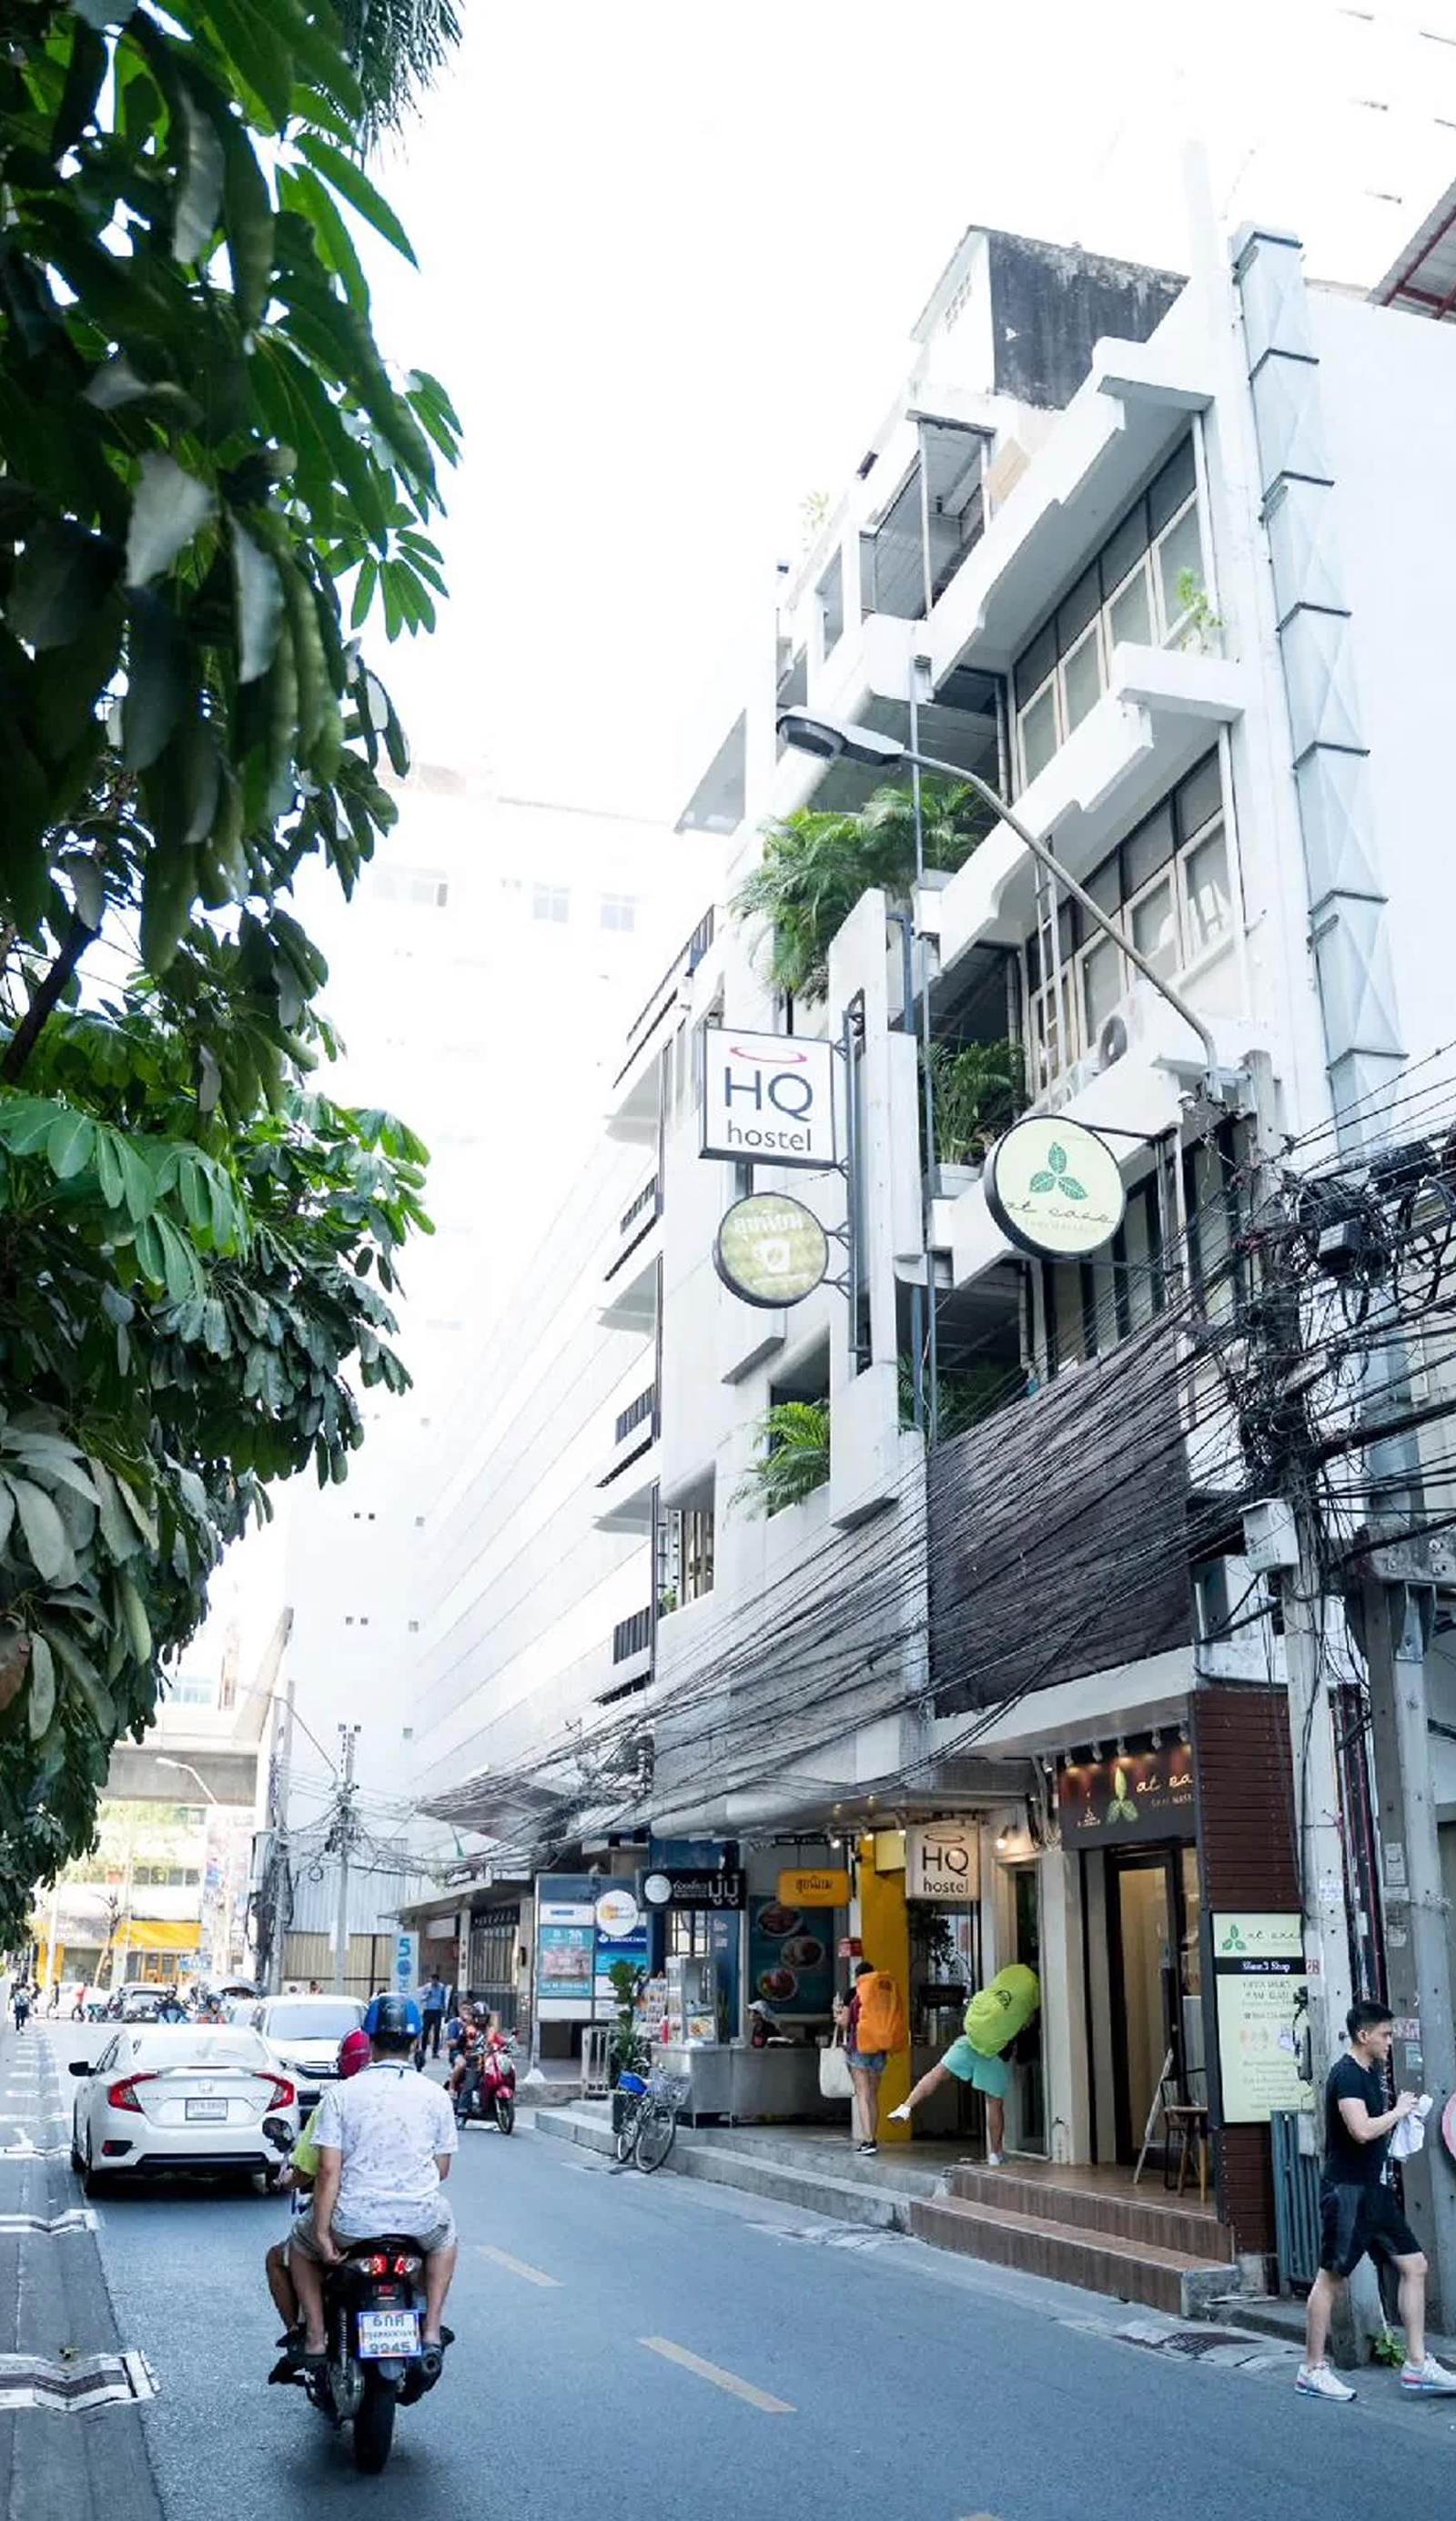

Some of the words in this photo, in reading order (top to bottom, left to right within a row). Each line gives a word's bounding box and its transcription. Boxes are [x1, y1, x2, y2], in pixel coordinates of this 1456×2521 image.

[725, 1066, 813, 1122] HQ
[728, 1119, 811, 1151] hostel
[923, 1846, 969, 1877] HQ
[923, 1877, 969, 1893] hostel
[1270, 1960, 1290, 1974] Shop
